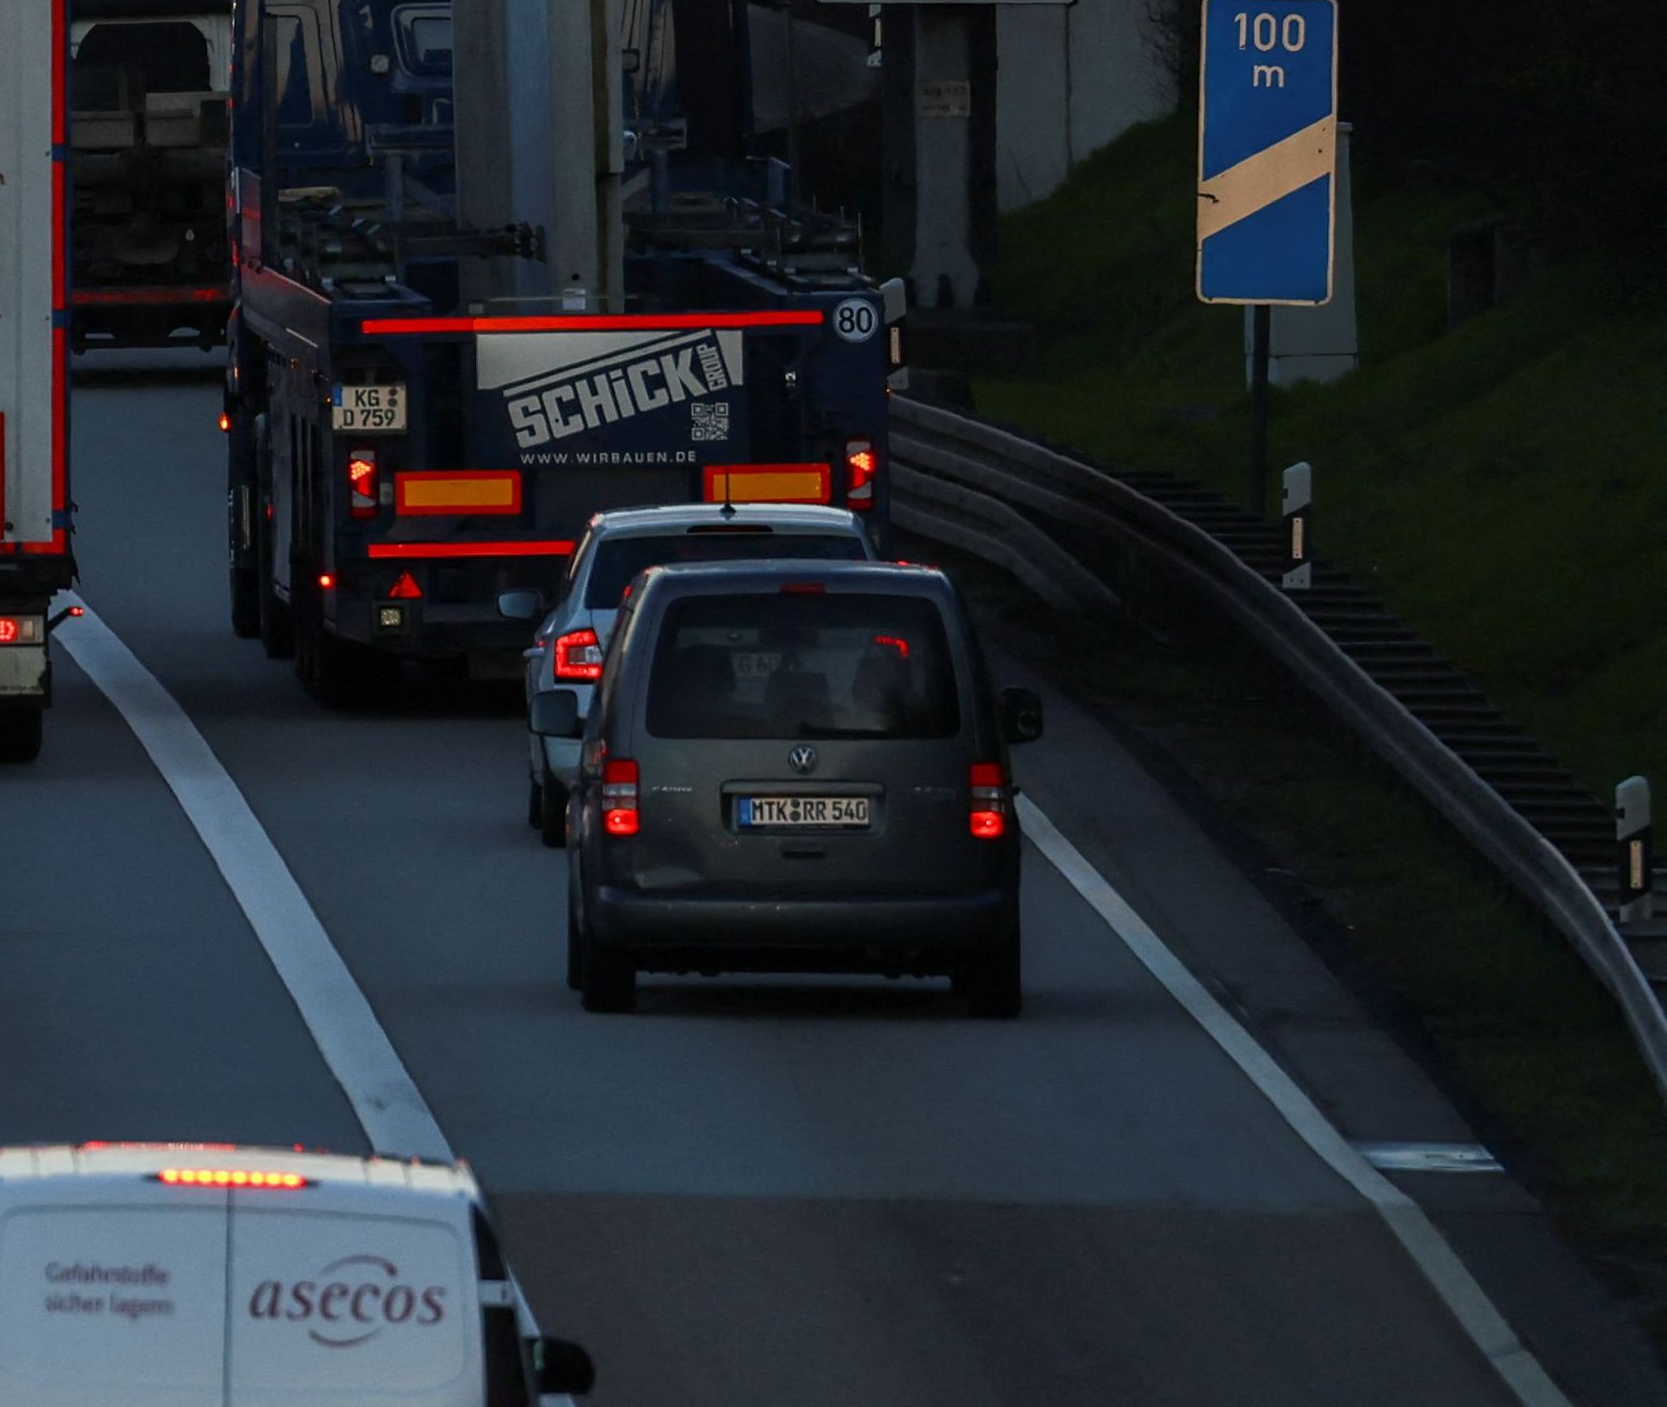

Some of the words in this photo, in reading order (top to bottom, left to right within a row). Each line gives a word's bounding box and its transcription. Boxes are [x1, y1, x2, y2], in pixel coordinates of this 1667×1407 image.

[1233, 12, 1306, 52] 100
[1252, 64, 1286, 89] m
[838, 306, 873, 334] 80
[696, 342, 726, 391] GROUP
[354, 389, 381, 409] KG
[342, 409, 355, 427] D
[359, 409, 396, 427] 759
[519, 450, 697, 466] WWW.WIRBAUEN.DE
[752, 800, 789, 822] MTK
[803, 800, 828, 822] RR
[831, 800, 868, 821] 540
[45, 1261, 172, 1286] Gefahrstoffe
[45, 1292, 104, 1313] sicher
[109, 1291, 176, 1319] lagern
[249, 1282, 447, 1326] asecos
